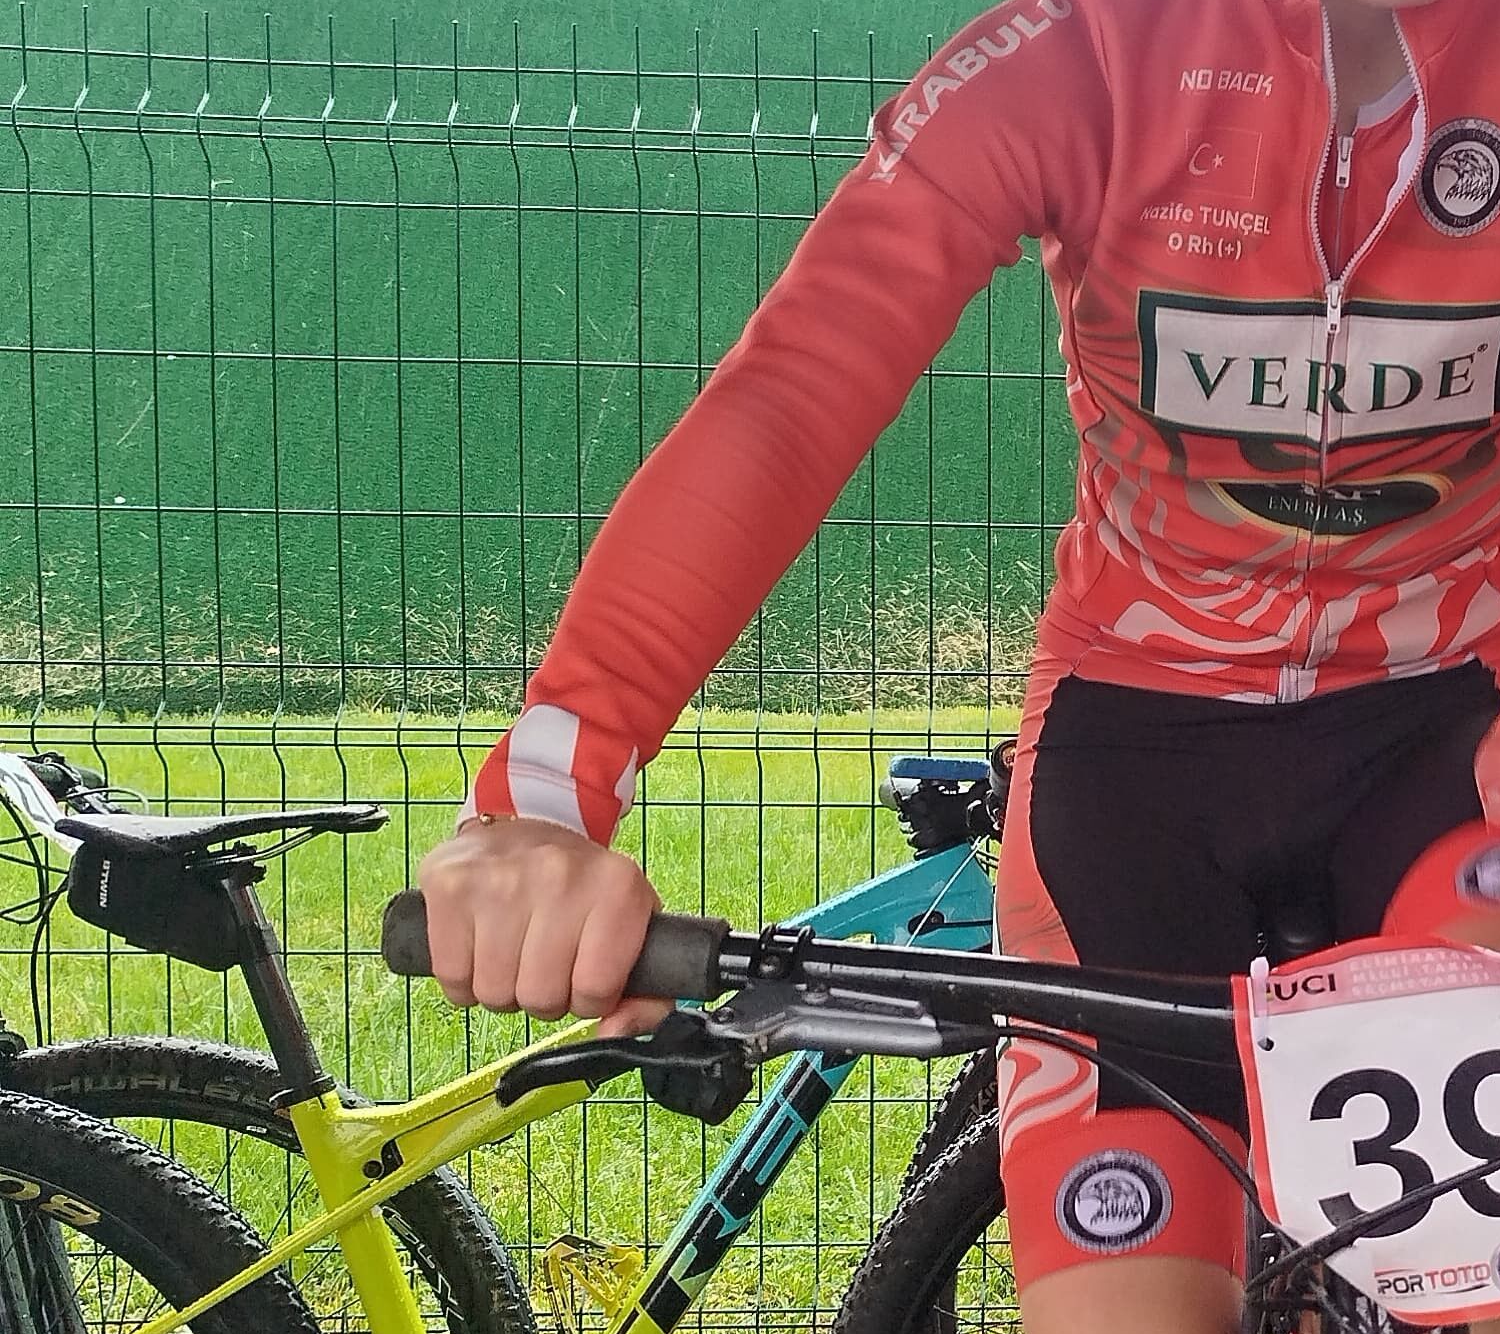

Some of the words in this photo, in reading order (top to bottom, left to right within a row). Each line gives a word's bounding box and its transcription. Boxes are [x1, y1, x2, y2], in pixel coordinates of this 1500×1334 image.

[1179, 69, 1214, 92] NO
[1218, 71, 1274, 96] BACK
[1200, 207, 1271, 236] TUNÇEL
[1182, 350, 1477, 415] VERDE
[1273, 972, 1337, 1002] UCI
